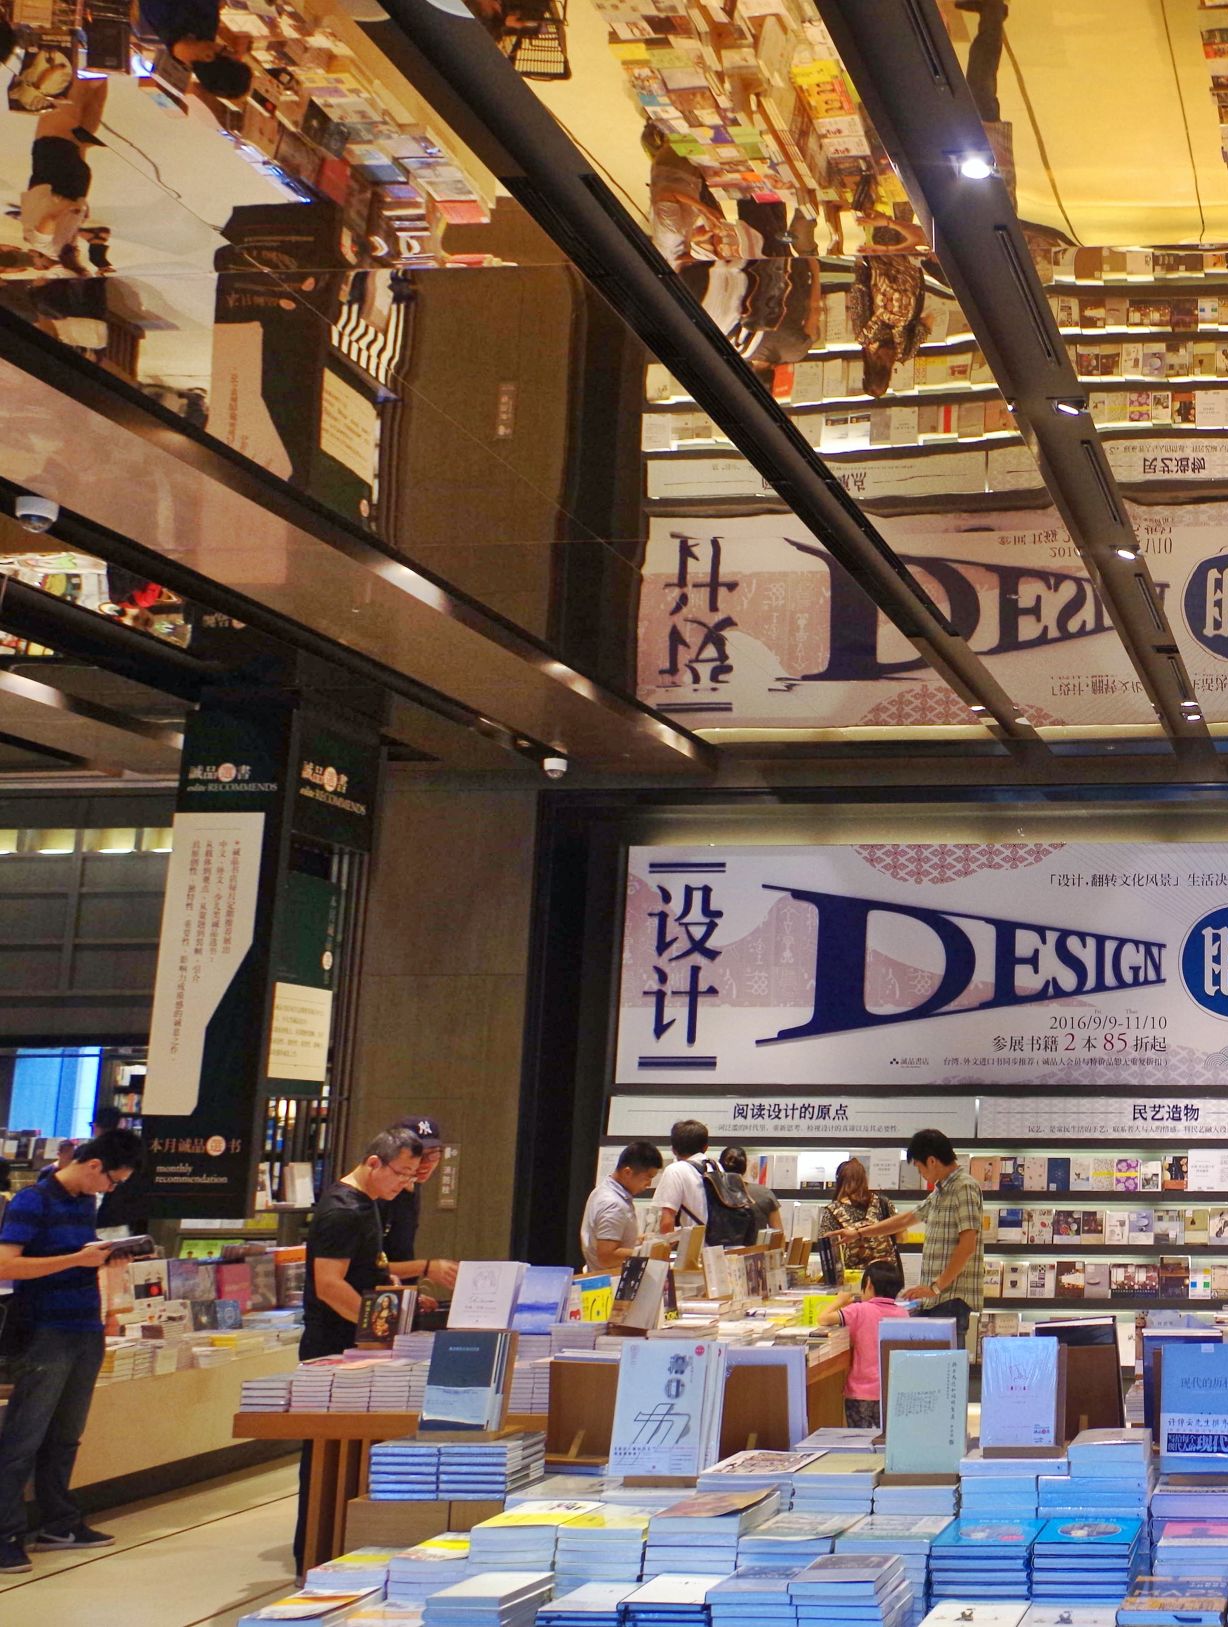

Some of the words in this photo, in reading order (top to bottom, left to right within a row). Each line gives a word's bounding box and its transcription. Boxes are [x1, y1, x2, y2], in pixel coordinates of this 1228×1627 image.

[643, 884, 726, 1046] 设计
[756, 884, 1166, 1046] DESIGN
[1049, 1015, 1167, 1031] 2016/9/9-11/10
[992, 1034, 1059, 1053] 参展书籍
[1064, 1033, 1076, 1052] 2
[1083, 1035, 1097, 1053] 本
[1103, 1032, 1128, 1053] 85
[1133, 1035, 1167, 1053] 折起
[732, 1103, 849, 1121] 阅读设计的原点
[1132, 1104, 1200, 1122] 民艺造物
[155, 1174, 228, 1185] recommendation
